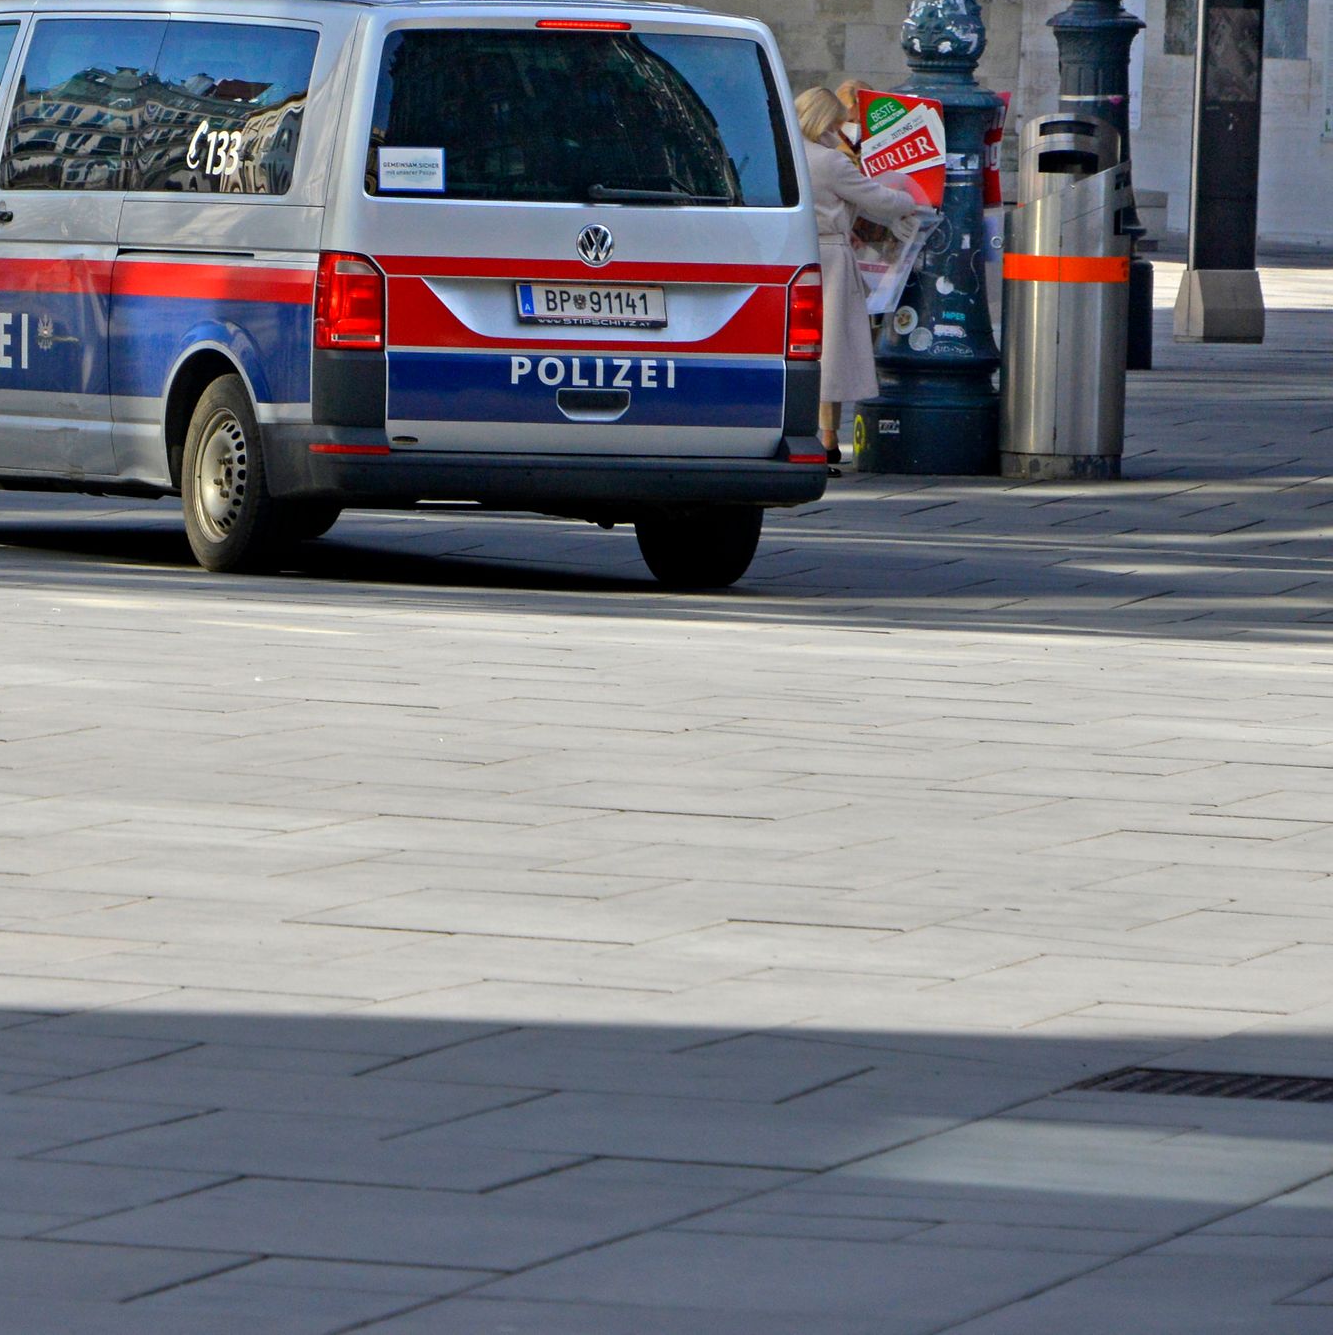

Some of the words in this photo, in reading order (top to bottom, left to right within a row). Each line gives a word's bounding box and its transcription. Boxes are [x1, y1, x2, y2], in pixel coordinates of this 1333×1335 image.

[870, 101, 896, 122] BESTE
[206, 130, 241, 175] 133
[868, 136, 935, 173] KURIER
[544, 289, 571, 313] BP
[589, 291, 649, 315] 91141
[510, 356, 676, 389] POLIZEI
